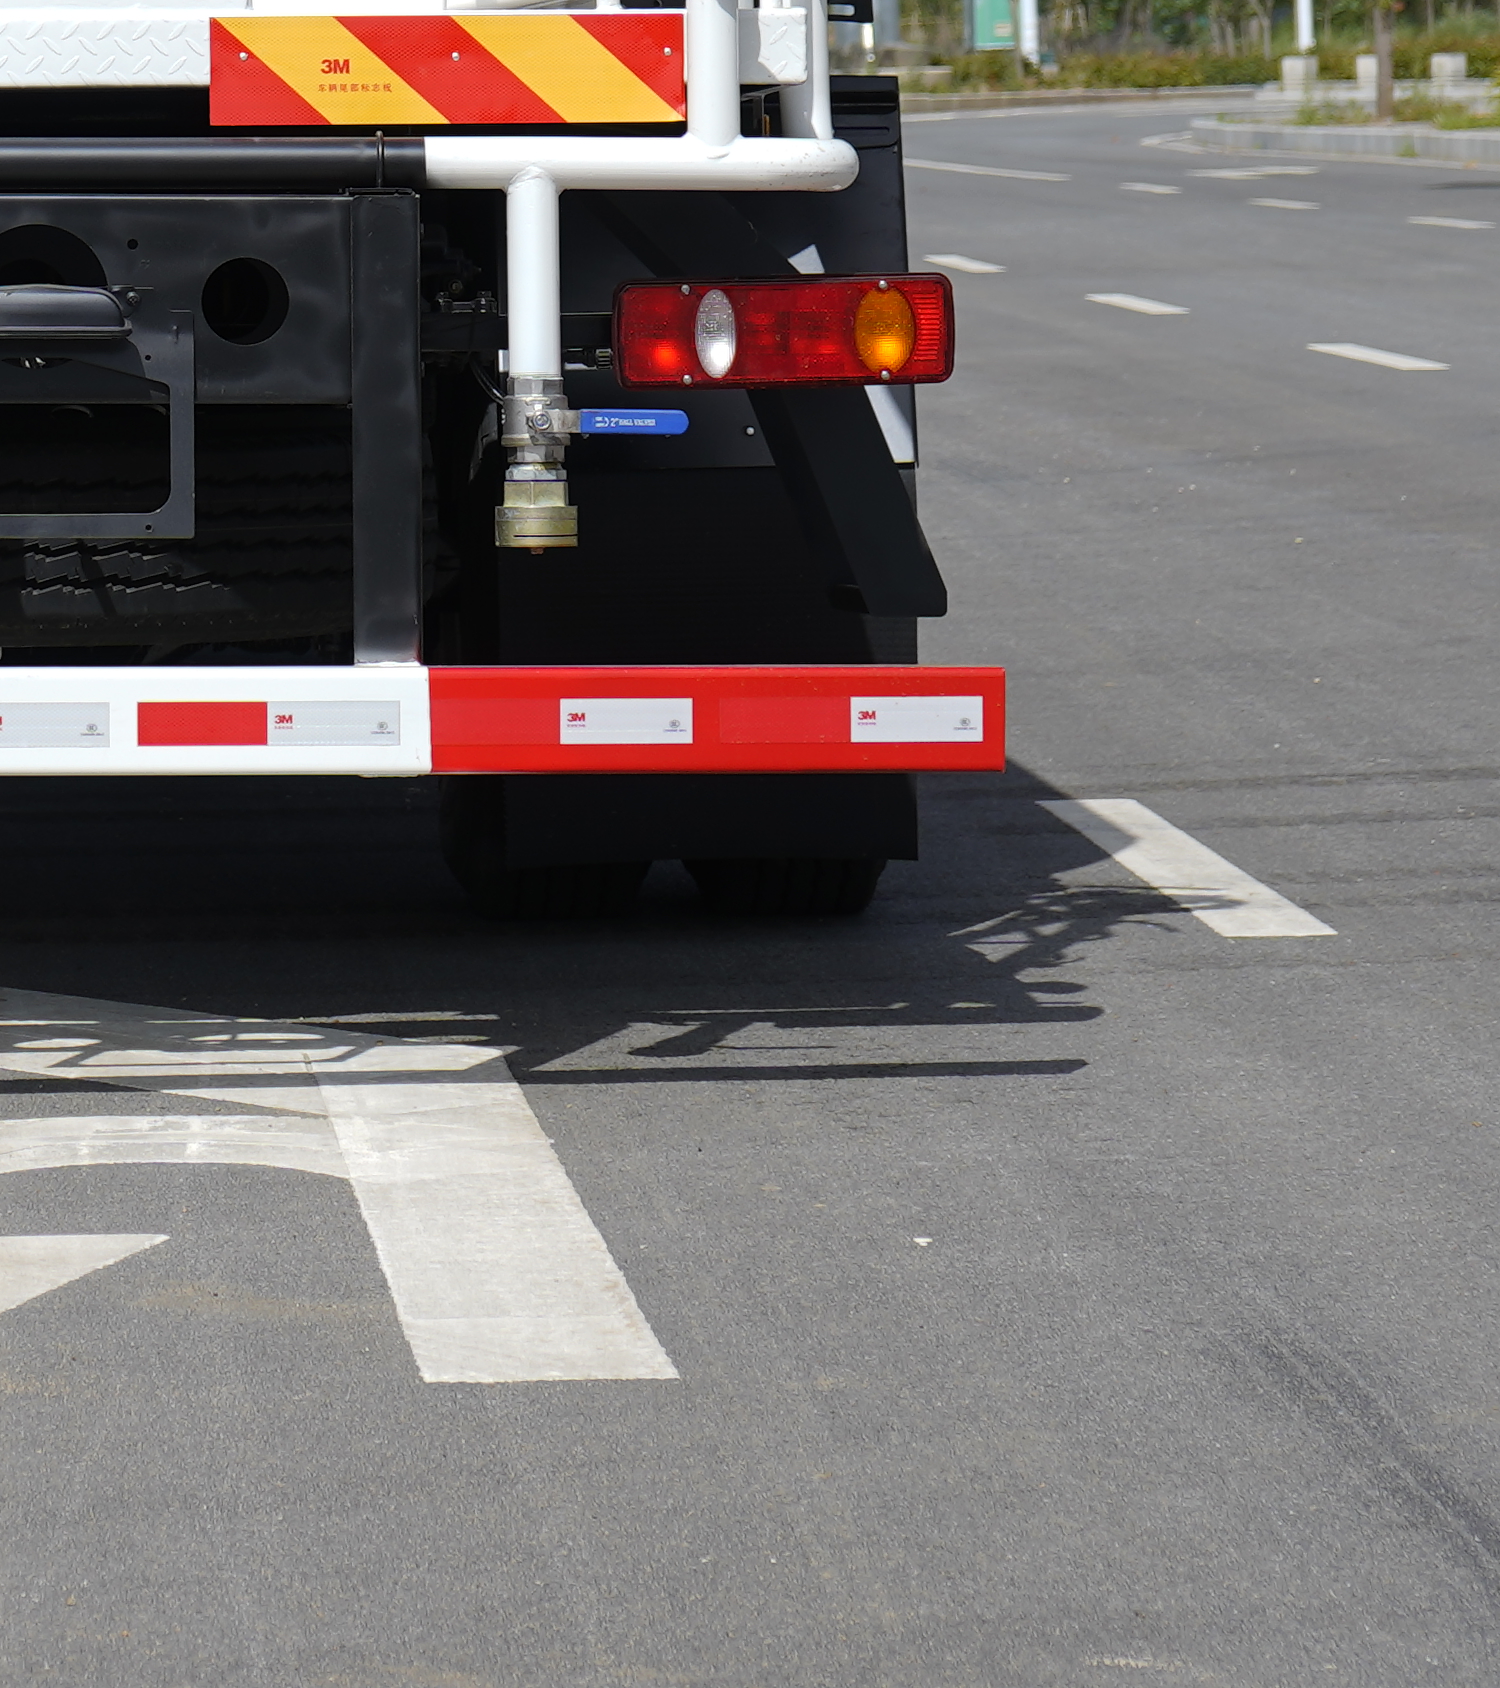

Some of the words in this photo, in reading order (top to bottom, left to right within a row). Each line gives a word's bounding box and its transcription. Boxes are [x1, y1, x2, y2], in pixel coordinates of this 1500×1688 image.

[320, 59, 350, 74] 3M
[274, 714, 293, 724] 3M
[566, 712, 585, 722] 3M
[858, 710, 876, 720] 3M
